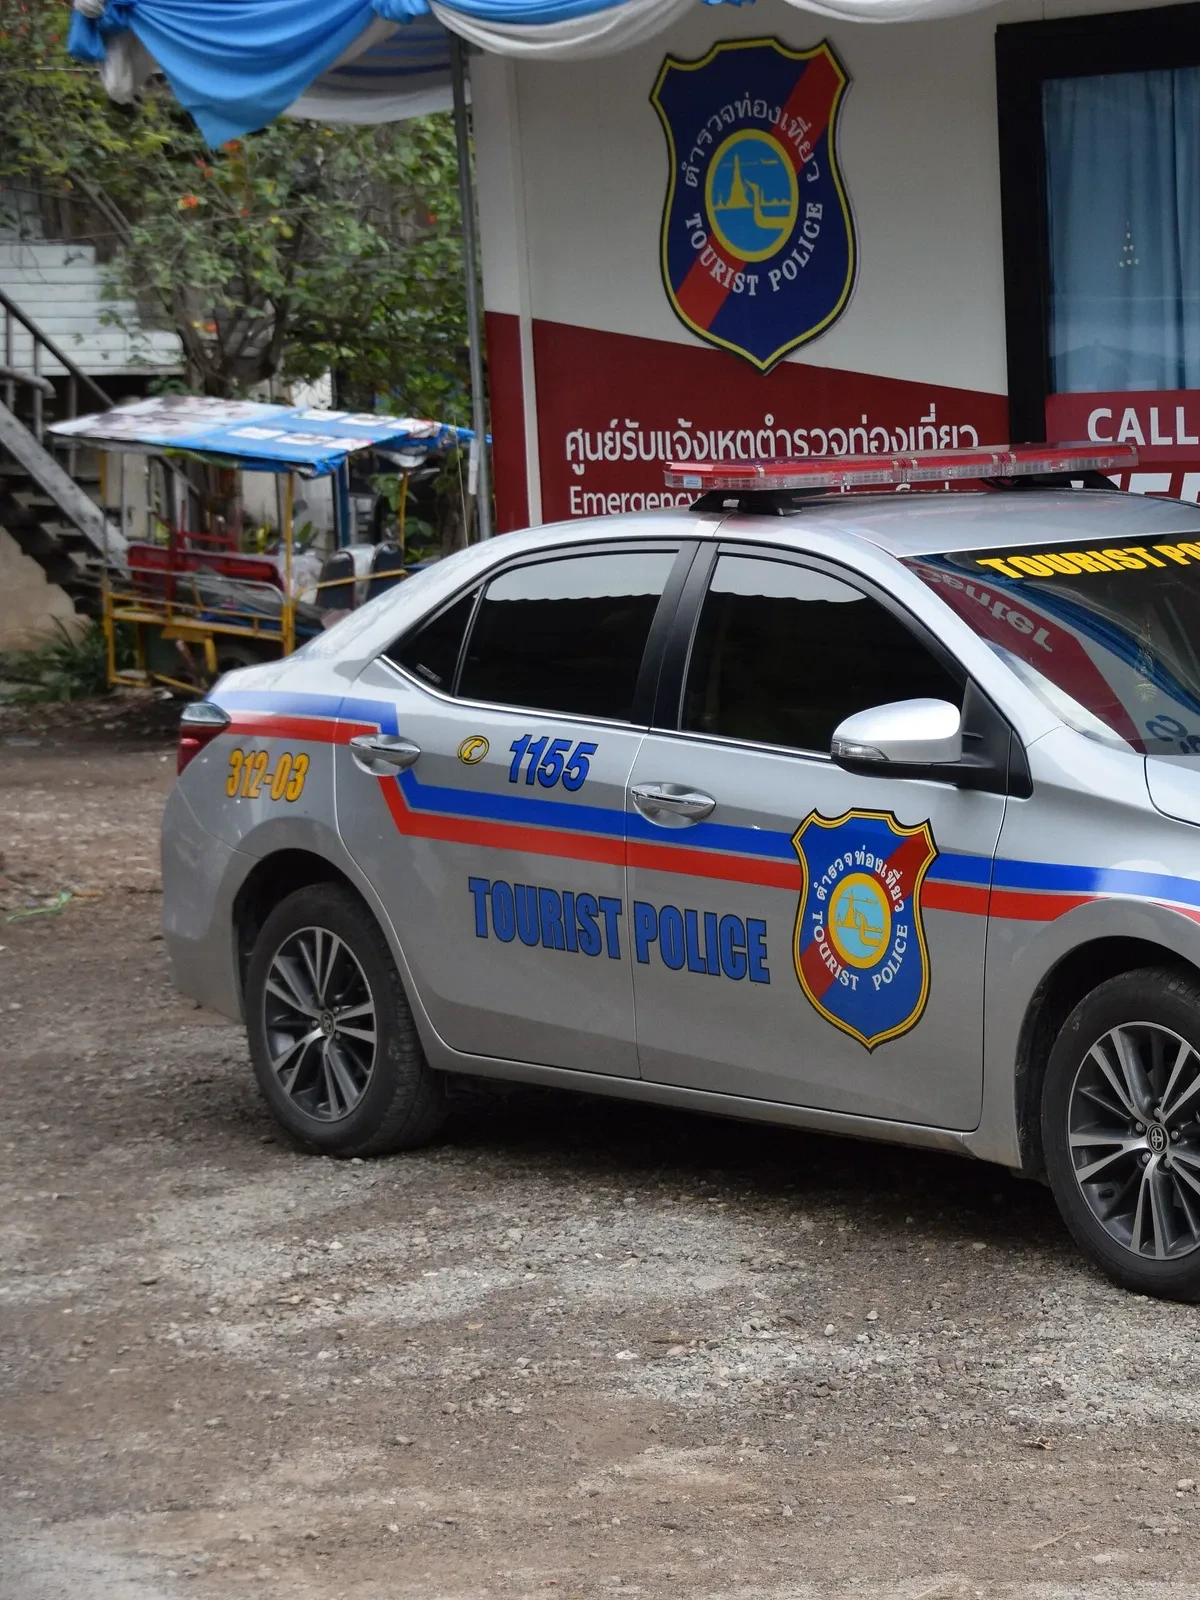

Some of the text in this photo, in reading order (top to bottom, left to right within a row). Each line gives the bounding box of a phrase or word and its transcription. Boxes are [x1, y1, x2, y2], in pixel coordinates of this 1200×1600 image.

[682, 93, 821, 188] ตำรวจท่องเที่ยว
[685, 203, 823, 296] TOURIST POLICE
[1087, 406, 1199, 446] CALL
[975, 546, 1167, 580] TOURIST
[226, 748, 310, 802] 312-03
[509, 734, 599, 792] 1155
[813, 845, 904, 913] ตำรวจท่องเที่ยว
[468, 876, 771, 984] TOURIST POLICE
[812, 911, 908, 991] TOURIST POLICE
